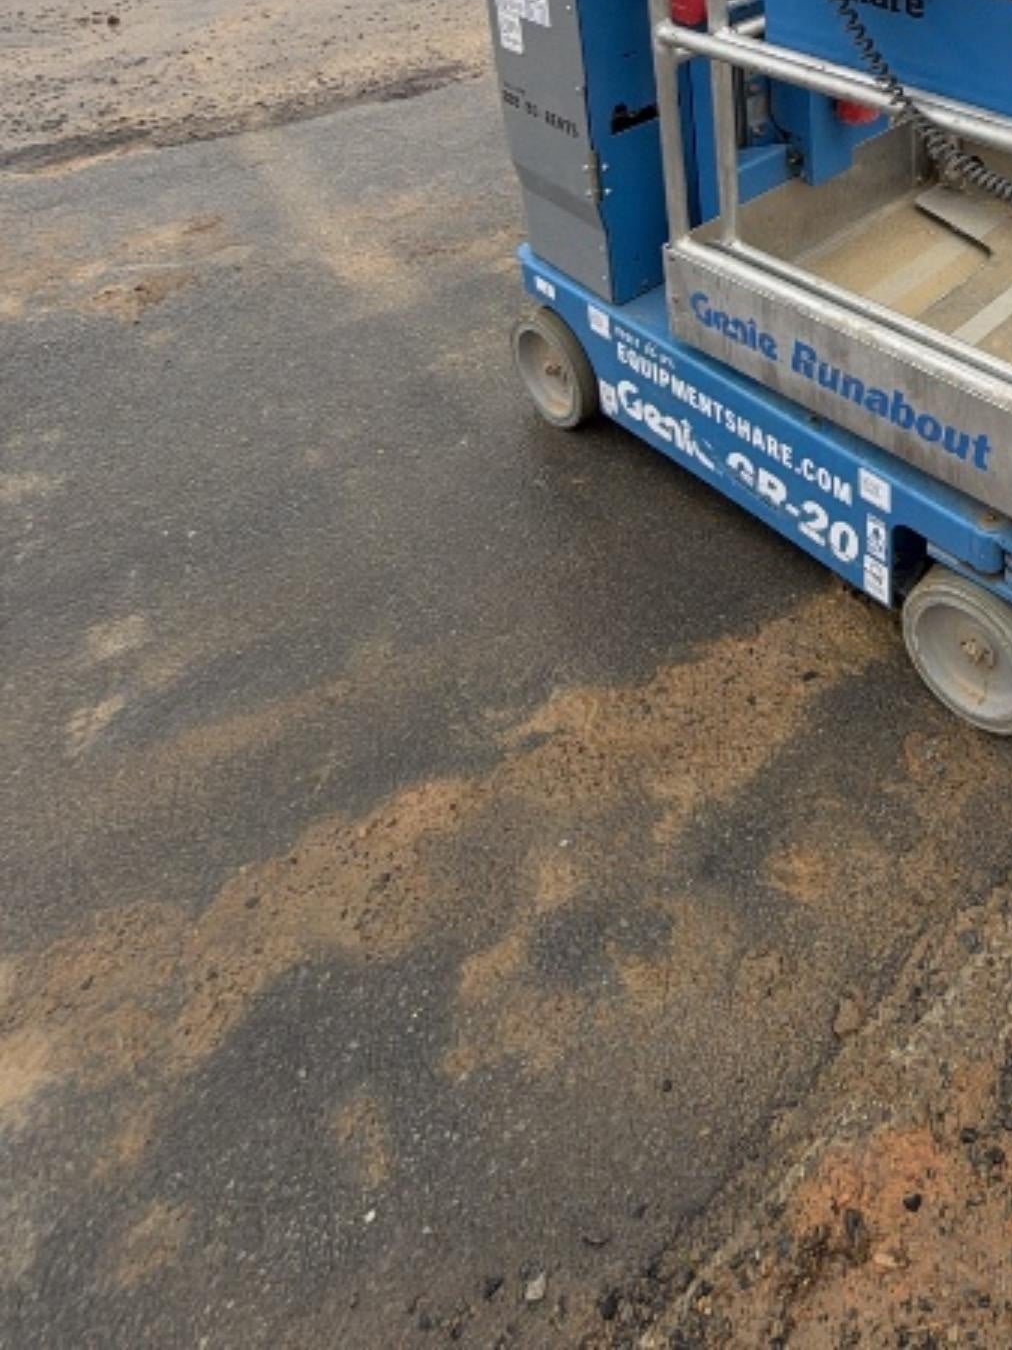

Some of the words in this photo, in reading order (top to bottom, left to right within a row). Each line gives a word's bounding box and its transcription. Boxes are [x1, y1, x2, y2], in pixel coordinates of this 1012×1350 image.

[616, 340, 853, 507] EQUIPMENTSHARE.COM
[689, 290, 779, 362] Genie
[790, 337, 993, 472] Runabout
